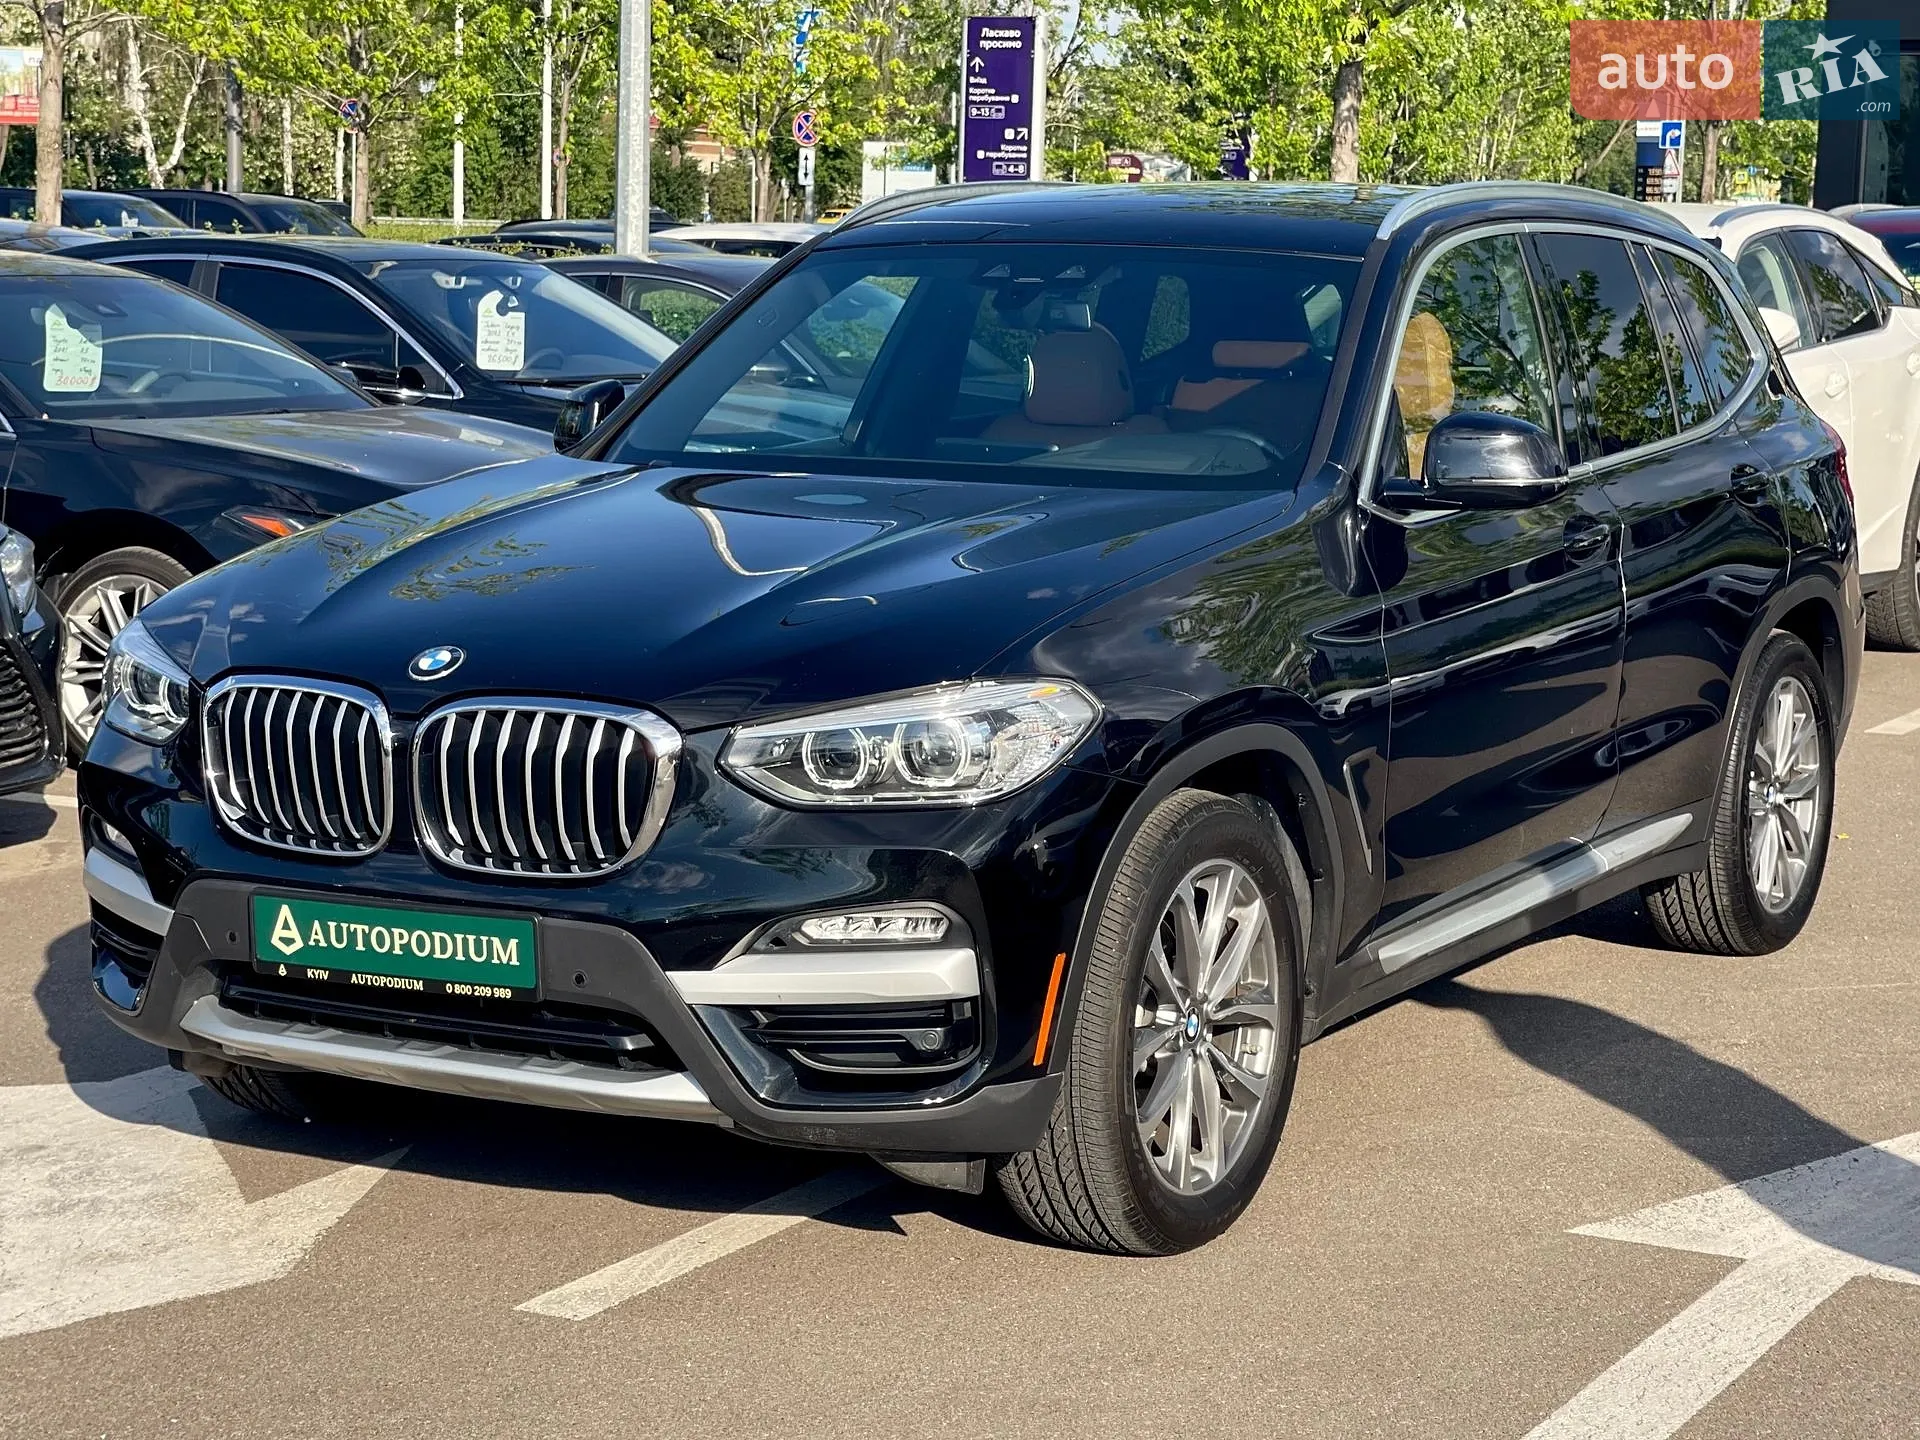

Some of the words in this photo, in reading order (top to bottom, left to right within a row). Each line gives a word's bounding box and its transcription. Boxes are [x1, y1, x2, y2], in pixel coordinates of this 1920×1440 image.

[981, 27, 1021, 38] Ласкаво
[980, 40, 1022, 50] просимо
[971, 107, 990, 117] 9-13
[1007, 164, 1025, 174] 4-8
[308, 919, 520, 966] AUTOPODIUM
[306, 968, 329, 980] KYIV
[350, 972, 424, 991] AUTOPODIUM
[445, 983, 452, 994] 0
[454, 984, 472, 996] 800
[473, 985, 492, 997] 209
[493, 987, 512, 999] 989
